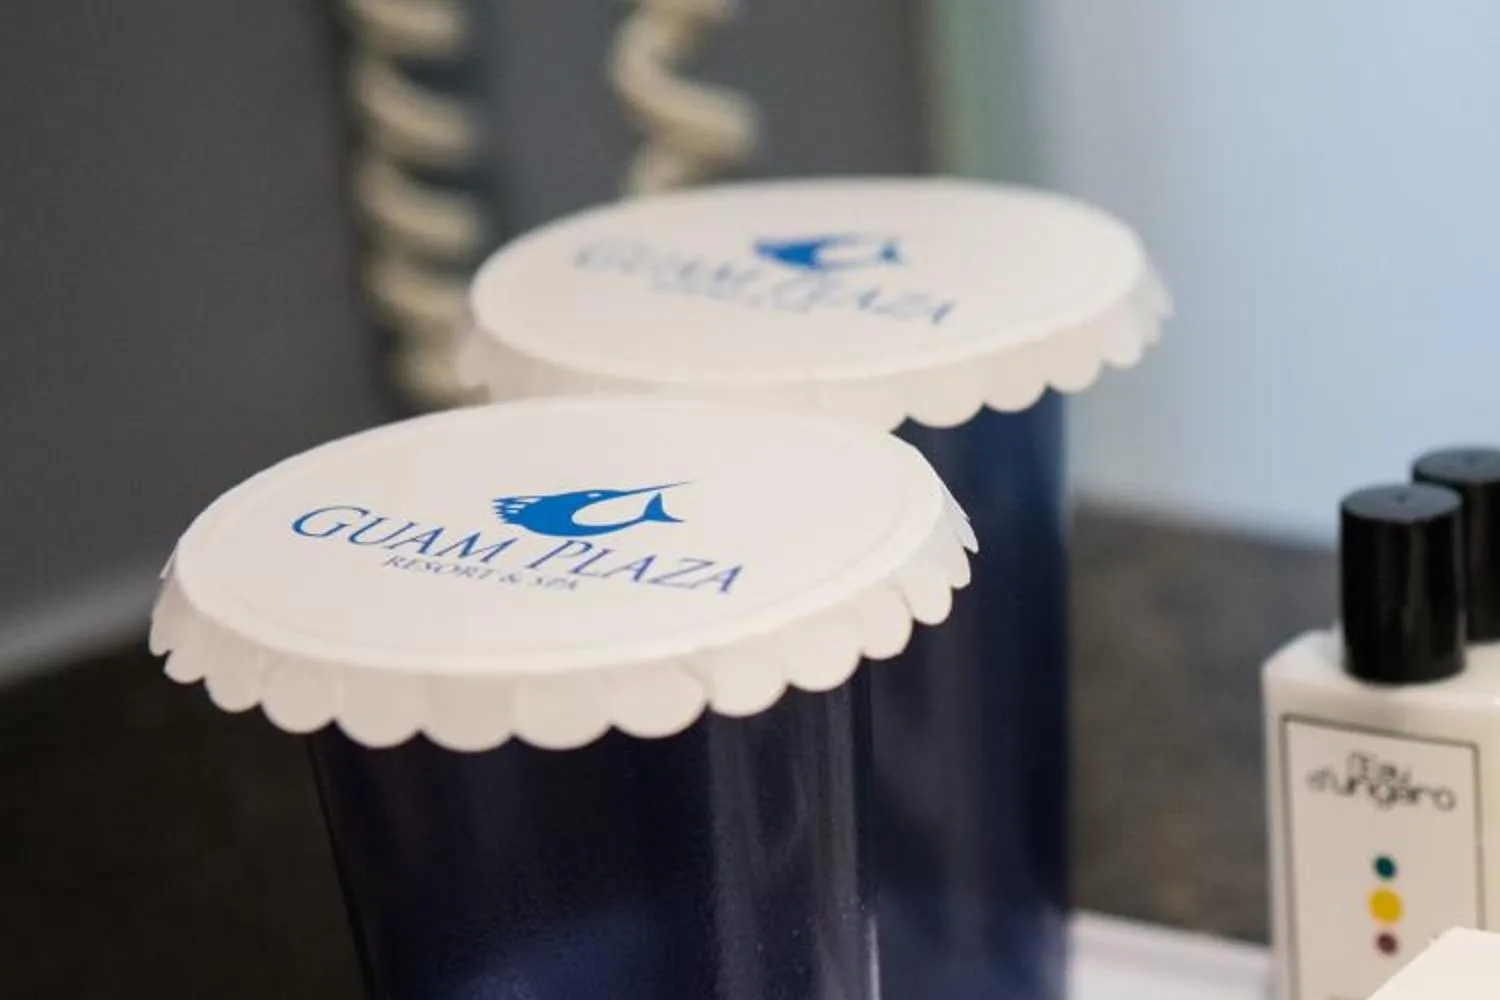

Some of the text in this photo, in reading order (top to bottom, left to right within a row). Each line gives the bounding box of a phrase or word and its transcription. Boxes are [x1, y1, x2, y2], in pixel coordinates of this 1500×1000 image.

[291, 505, 744, 594] GUAM PLAZA
[384, 555, 498, 580] RESORT
[526, 574, 578, 592] SPA
